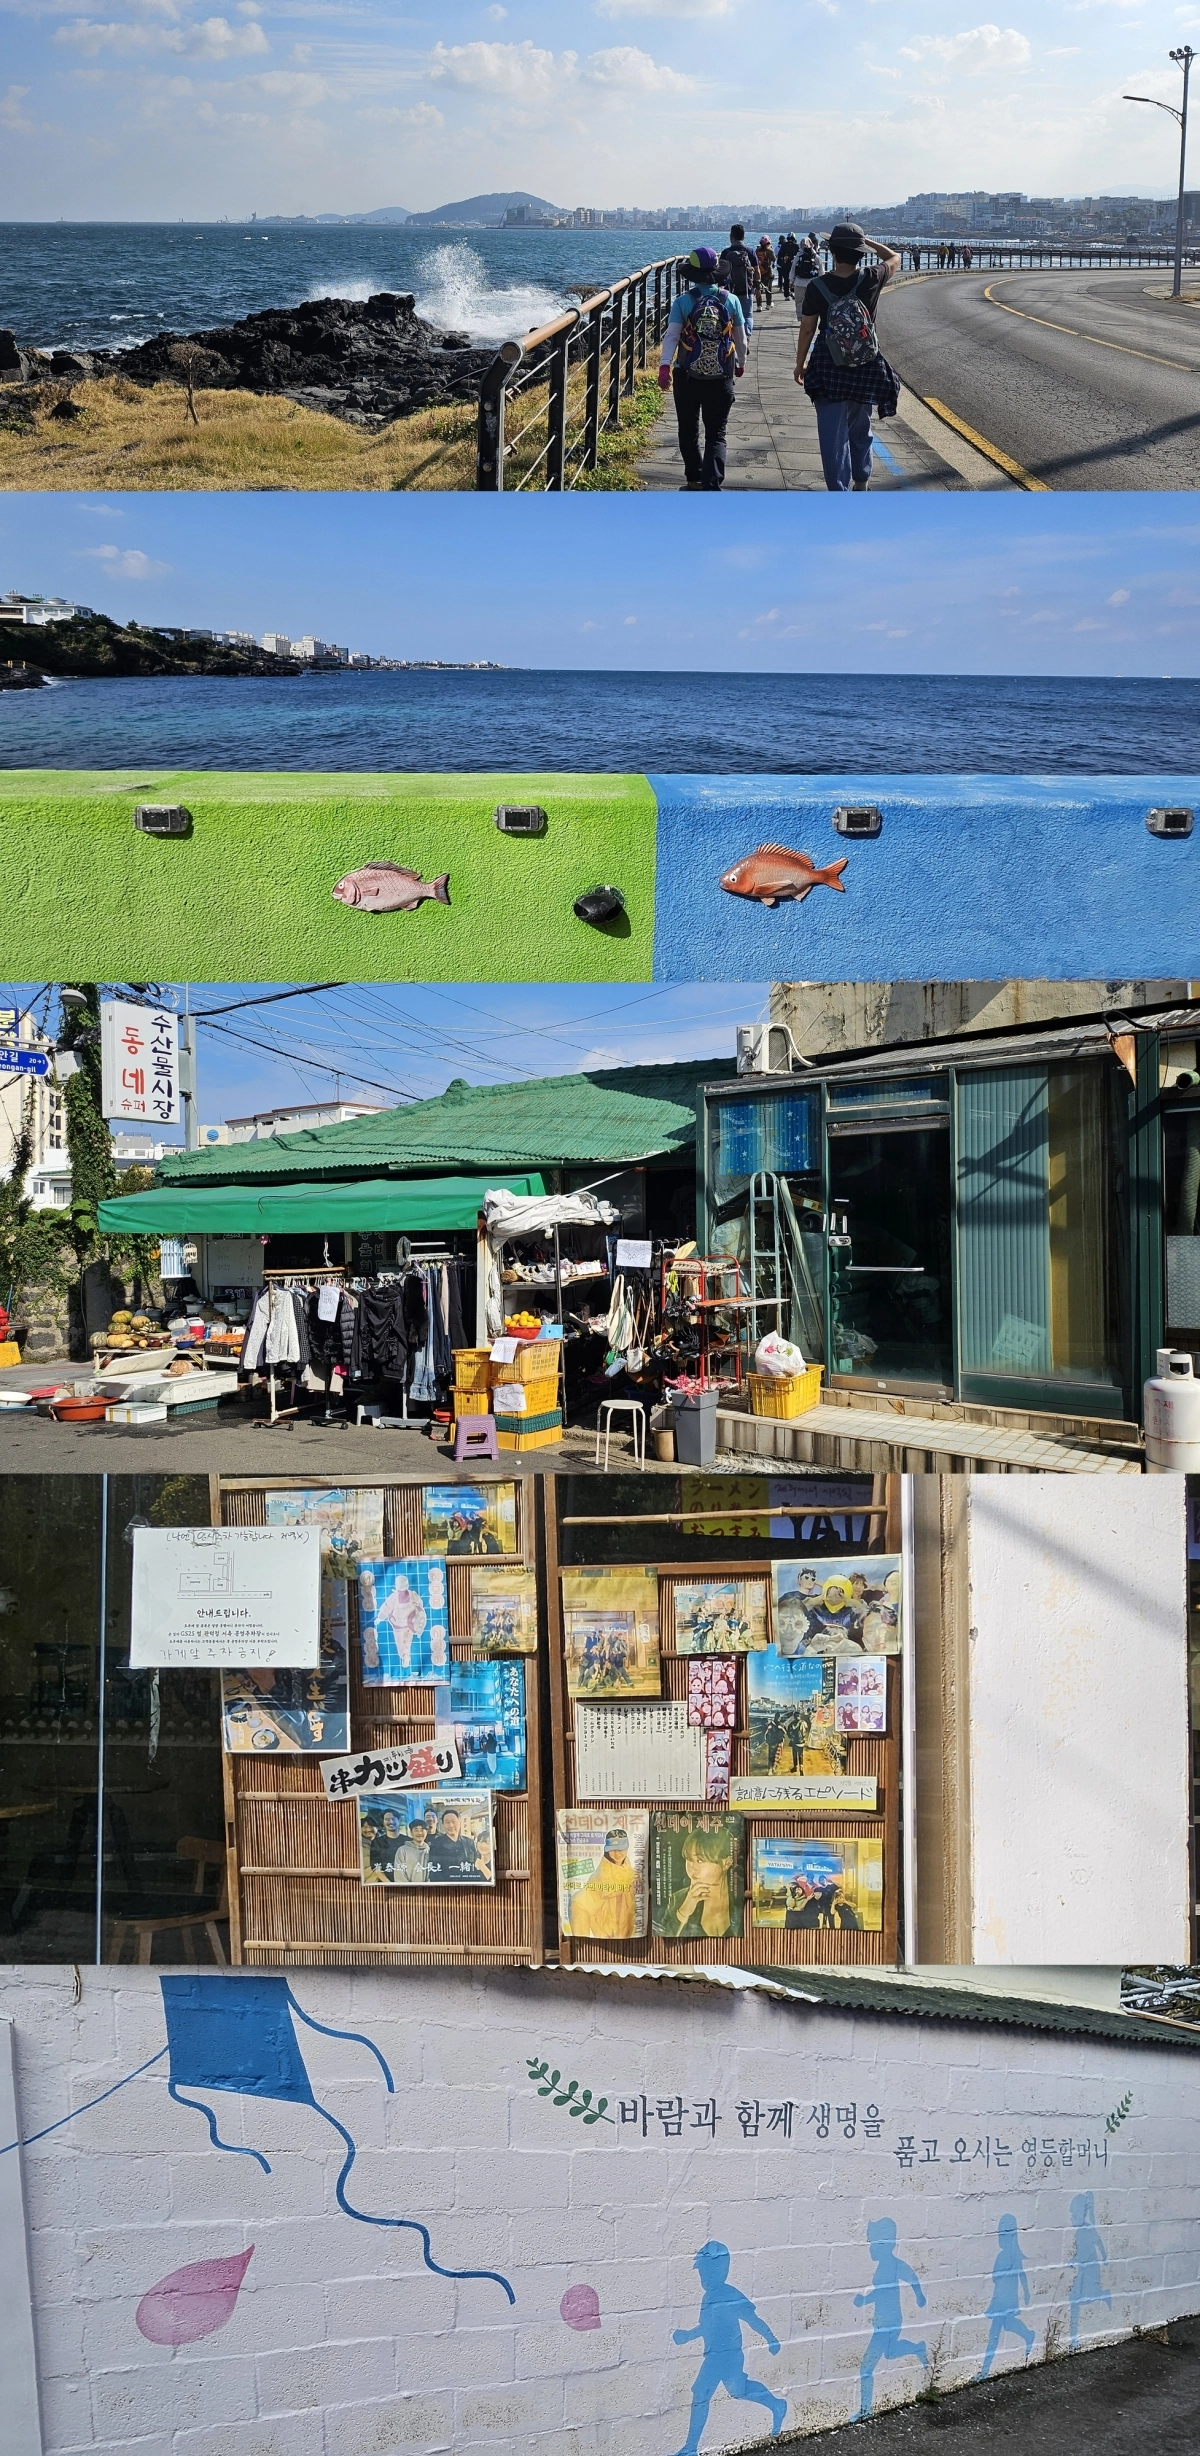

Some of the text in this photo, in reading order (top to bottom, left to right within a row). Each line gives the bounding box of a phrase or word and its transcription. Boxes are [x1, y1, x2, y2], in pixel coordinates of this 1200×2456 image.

[0, 1063, 37, 1074] ongan-gil
[121, 1026, 145, 1095] 동네
[151, 1014, 176, 1120] 수산물시장
[121, 1098, 146, 1113] 슈퍼
[690, 1480, 761, 1499] ラーメン
[196, 1608, 252, 1618] 안내드립니다.
[509, 1666, 520, 1727] あなたへの道
[329, 1745, 454, 1794] 串カツ盛り
[612, 1814, 645, 1831] 제주
[653, 1813, 724, 1834] 선데이 제주
[618, 2094, 886, 2139] 바람과 함께 생명을
[893, 2135, 1109, 2169] 품고 오시는 영등할머니
